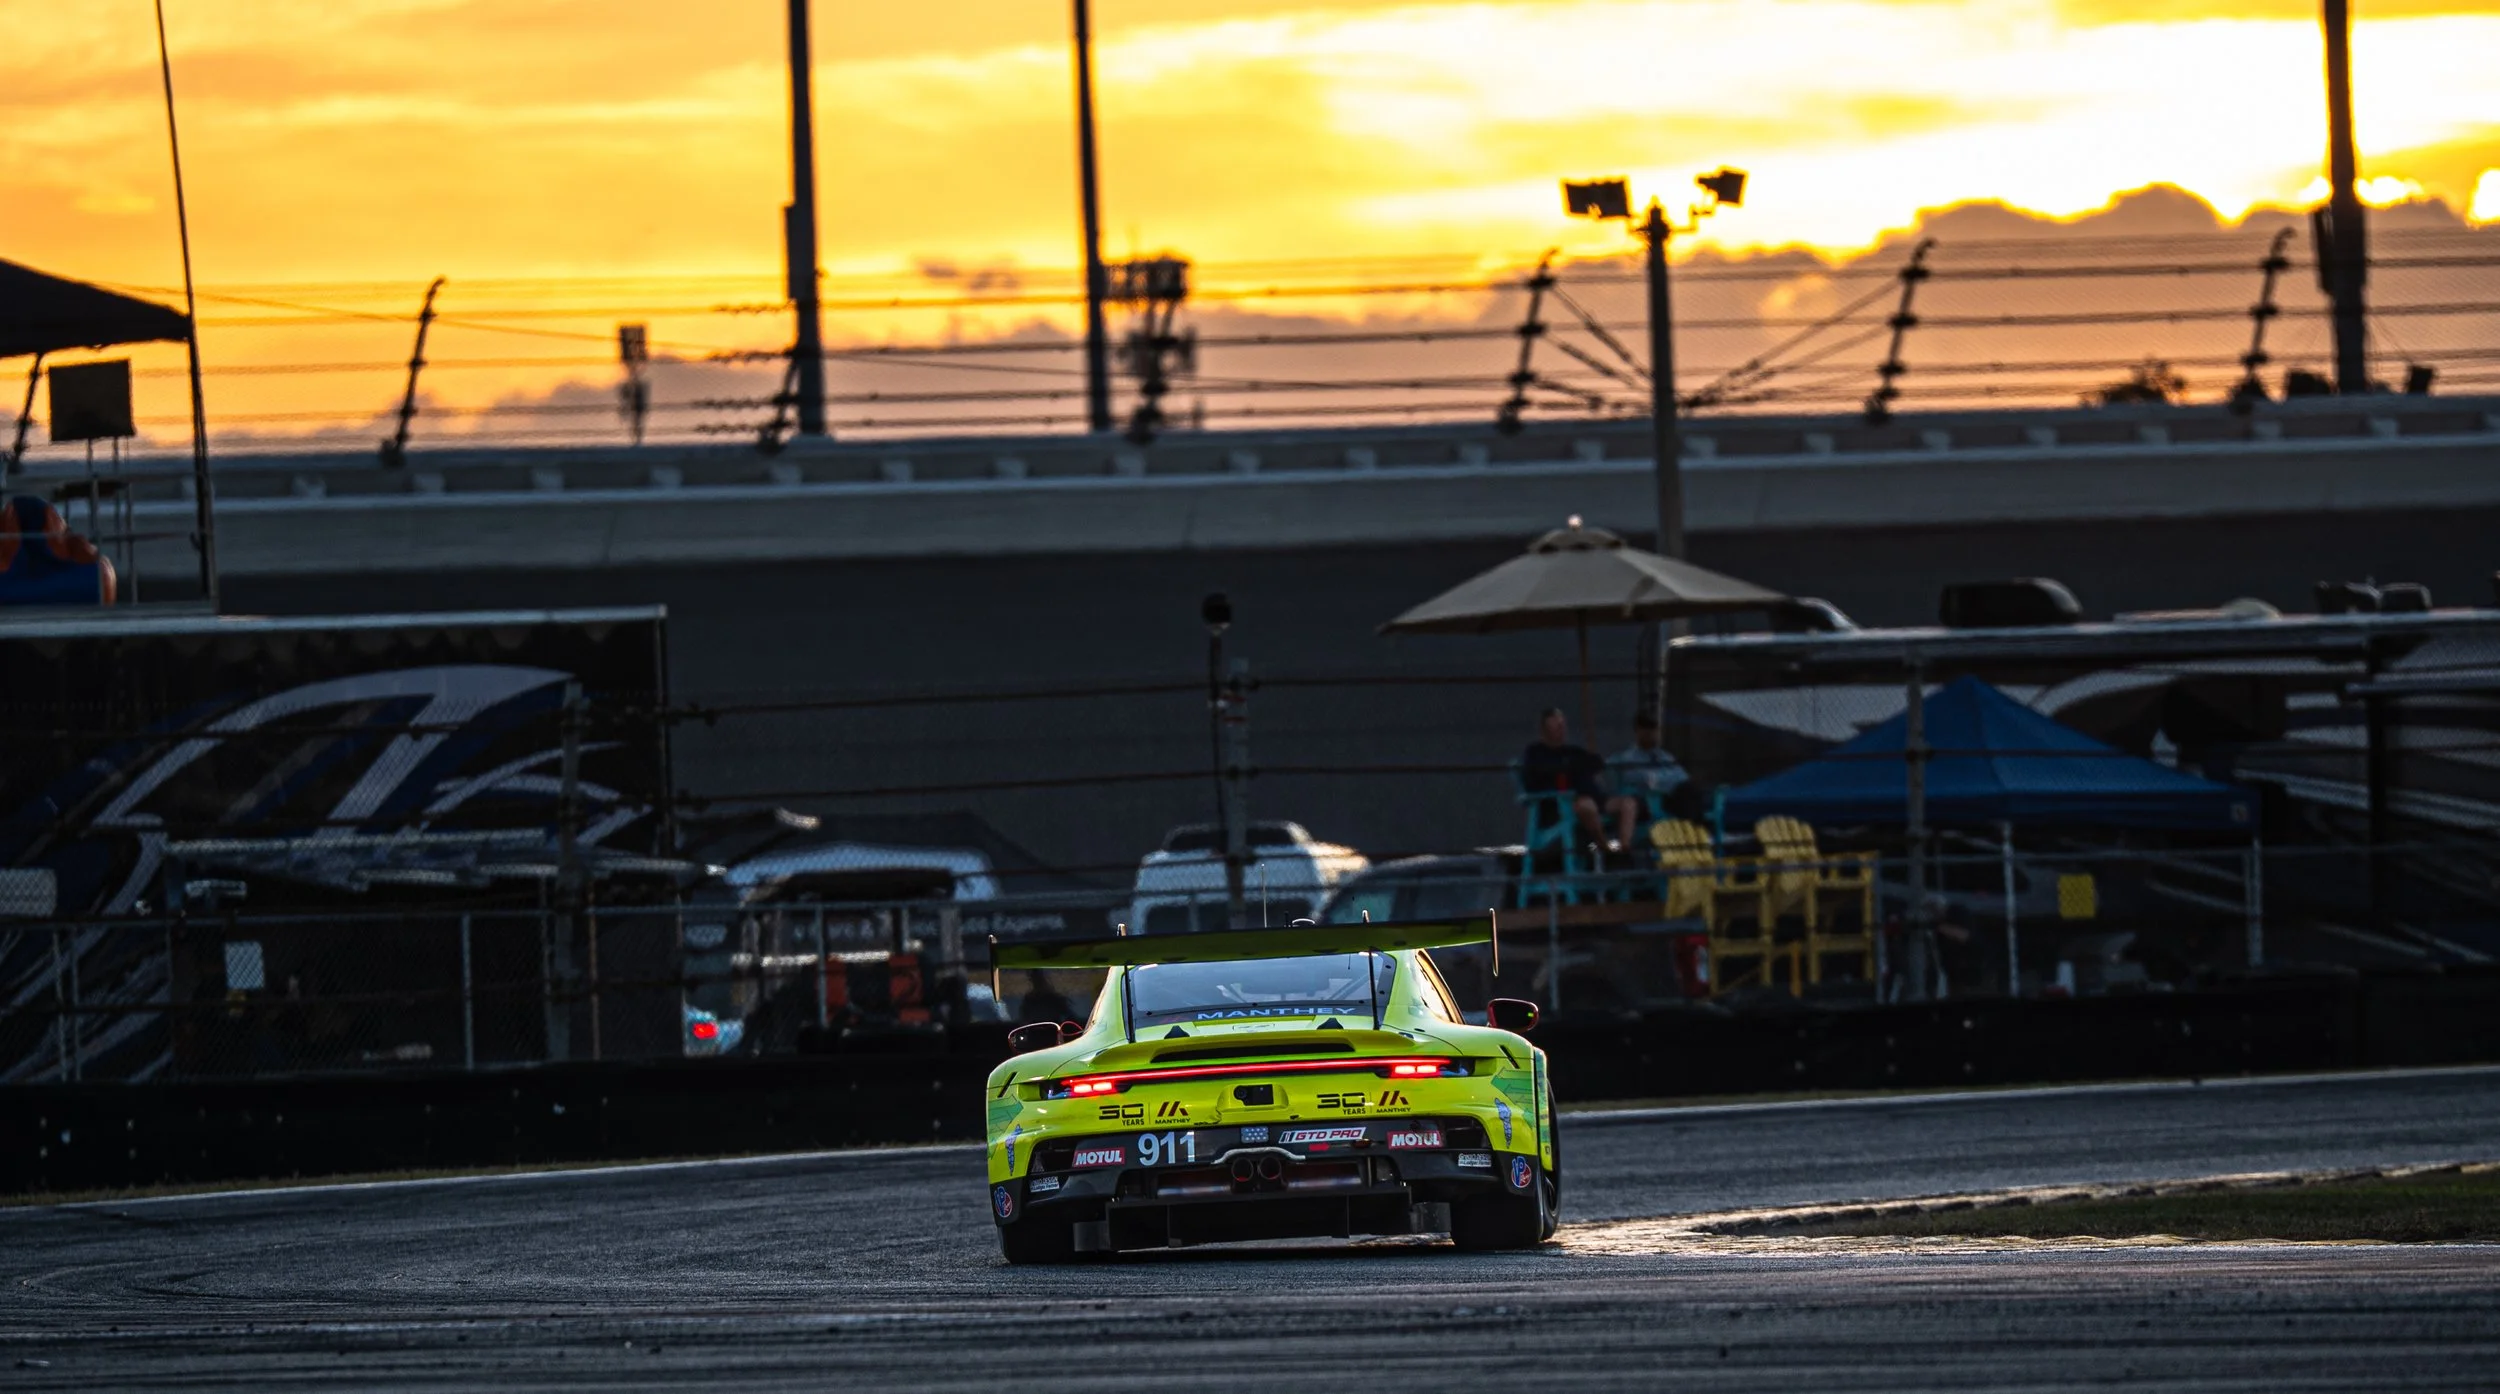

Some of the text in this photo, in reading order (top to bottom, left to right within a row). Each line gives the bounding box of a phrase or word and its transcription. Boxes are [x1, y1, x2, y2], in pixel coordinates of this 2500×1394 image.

[1197, 1007, 1356, 1020] MANTHEY
[1316, 1092, 1365, 1108] 30
[1099, 1103, 1144, 1120] 30
[1295, 1129, 1362, 1140] GTD PRO
[1391, 1133, 1440, 1147] MOTUL
[1138, 1131, 1195, 1166] 911
[1075, 1150, 1122, 1166] MOTUL
